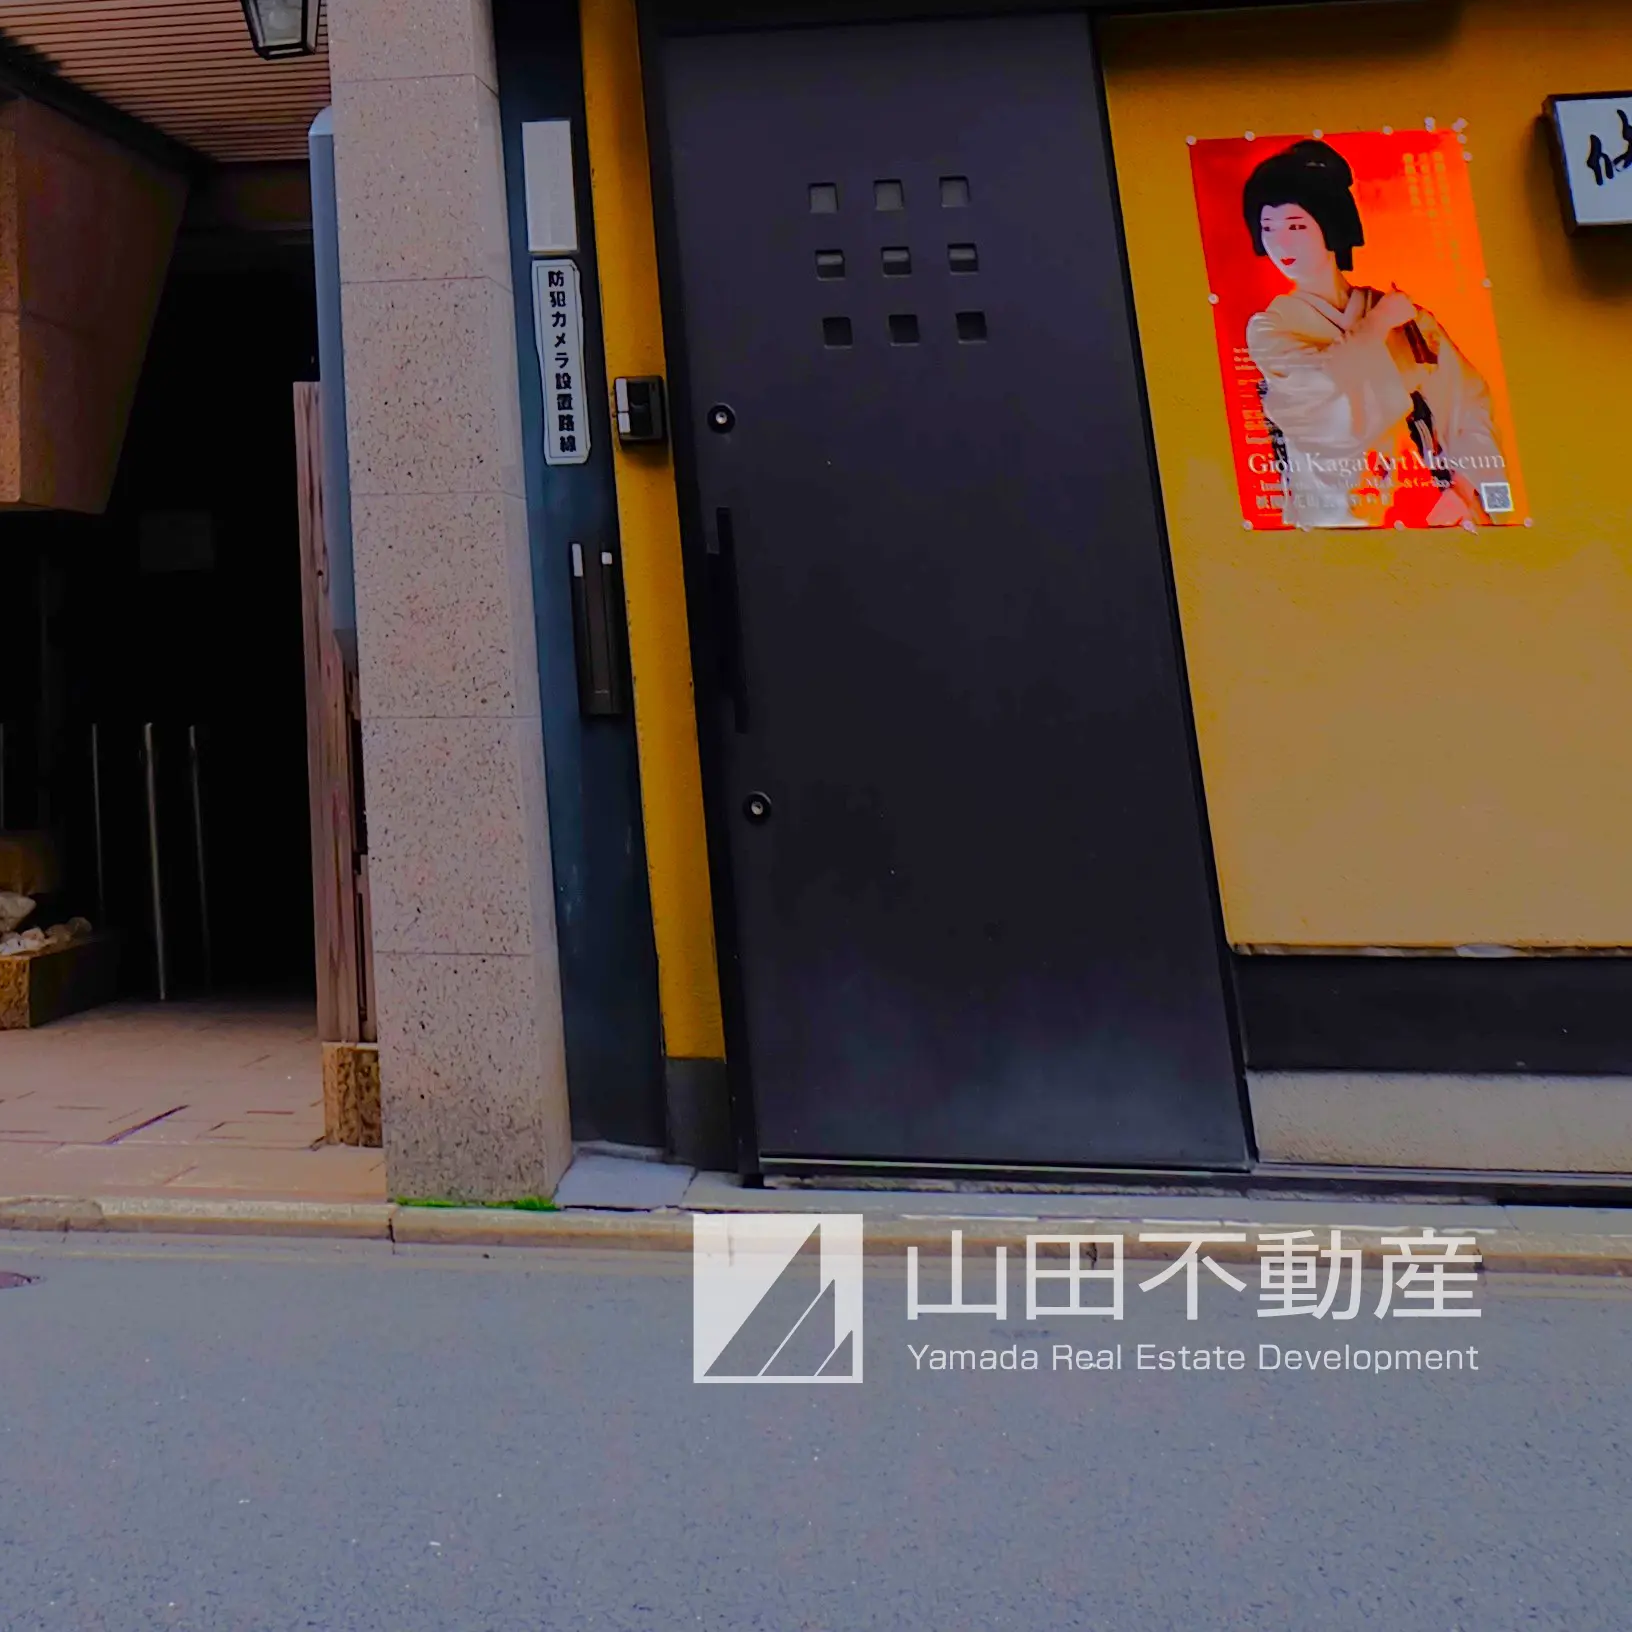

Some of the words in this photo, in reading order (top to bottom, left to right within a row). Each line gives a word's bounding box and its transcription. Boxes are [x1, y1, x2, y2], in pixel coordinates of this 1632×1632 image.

[547, 269, 577, 454] 防犯カメラ設置路線
[1248, 453, 1299, 475] Gion
[1305, 451, 1368, 481] Kagai
[1371, 447, 1407, 473] Art
[1409, 449, 1507, 473] Museum
